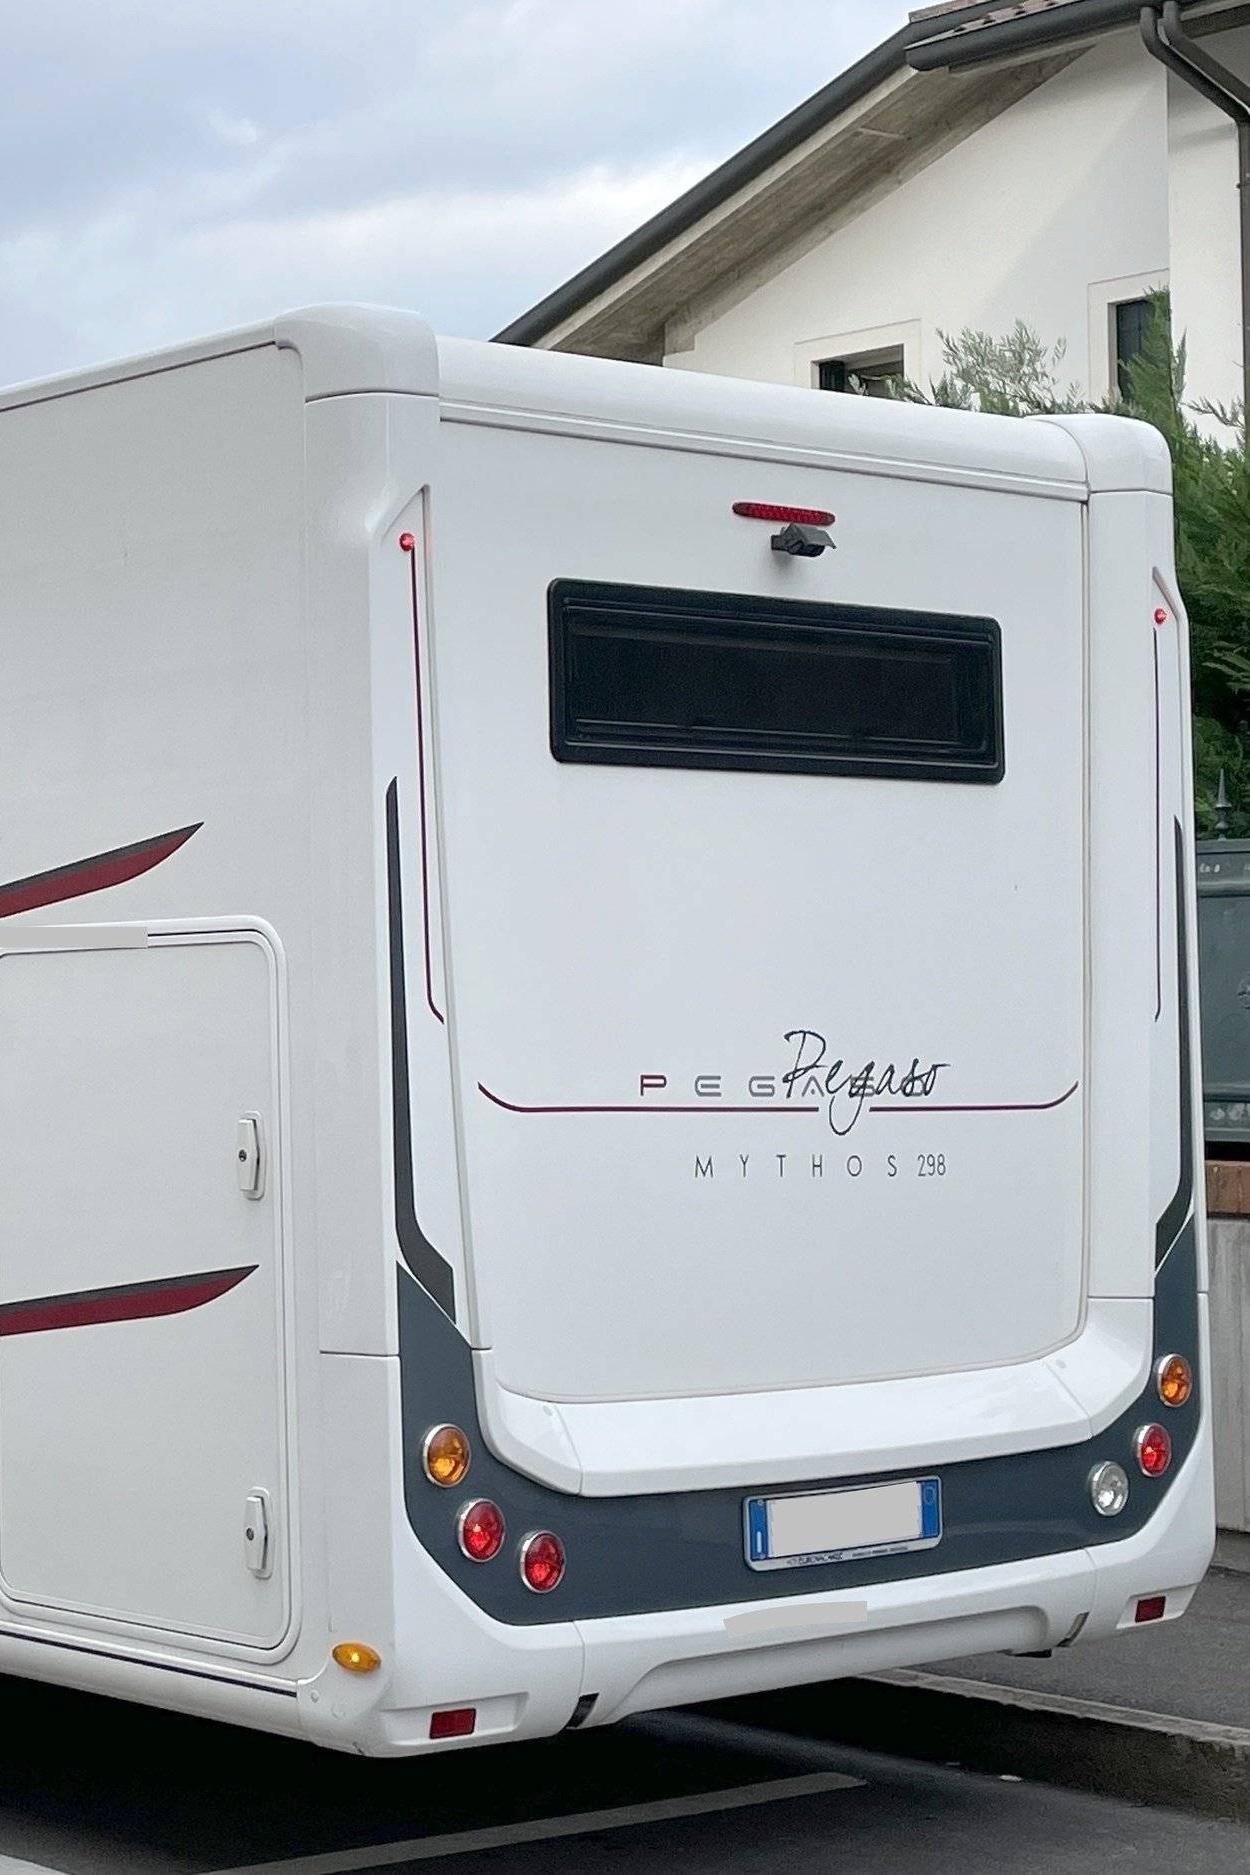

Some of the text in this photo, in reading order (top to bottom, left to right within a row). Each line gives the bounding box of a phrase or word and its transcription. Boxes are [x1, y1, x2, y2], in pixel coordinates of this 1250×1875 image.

[784, 1029, 951, 1136] Pegaso
[695, 1153, 947, 1178] MYTHOS 298
